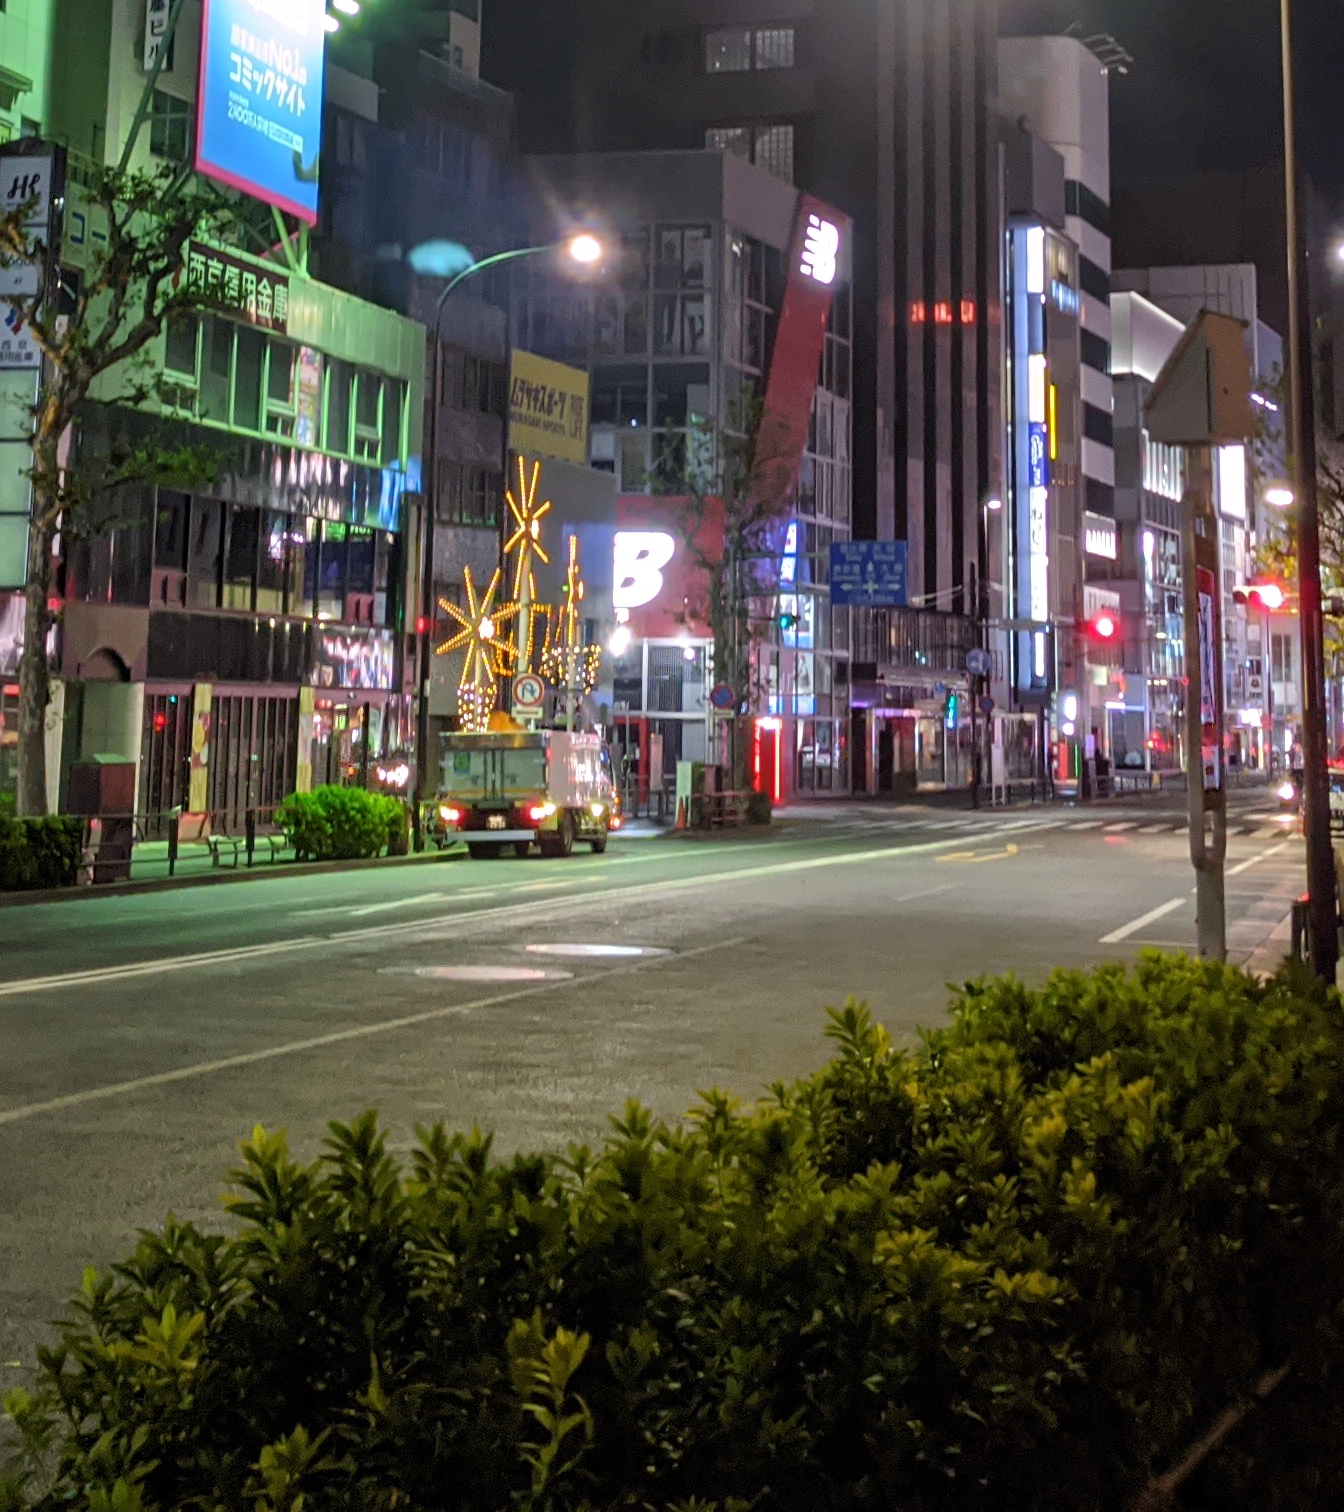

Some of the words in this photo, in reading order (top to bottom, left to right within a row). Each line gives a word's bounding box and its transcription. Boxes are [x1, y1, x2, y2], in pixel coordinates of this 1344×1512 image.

[229, 51, 306, 119] コミックサイト
[189, 251, 288, 324] 西京信用金庫
